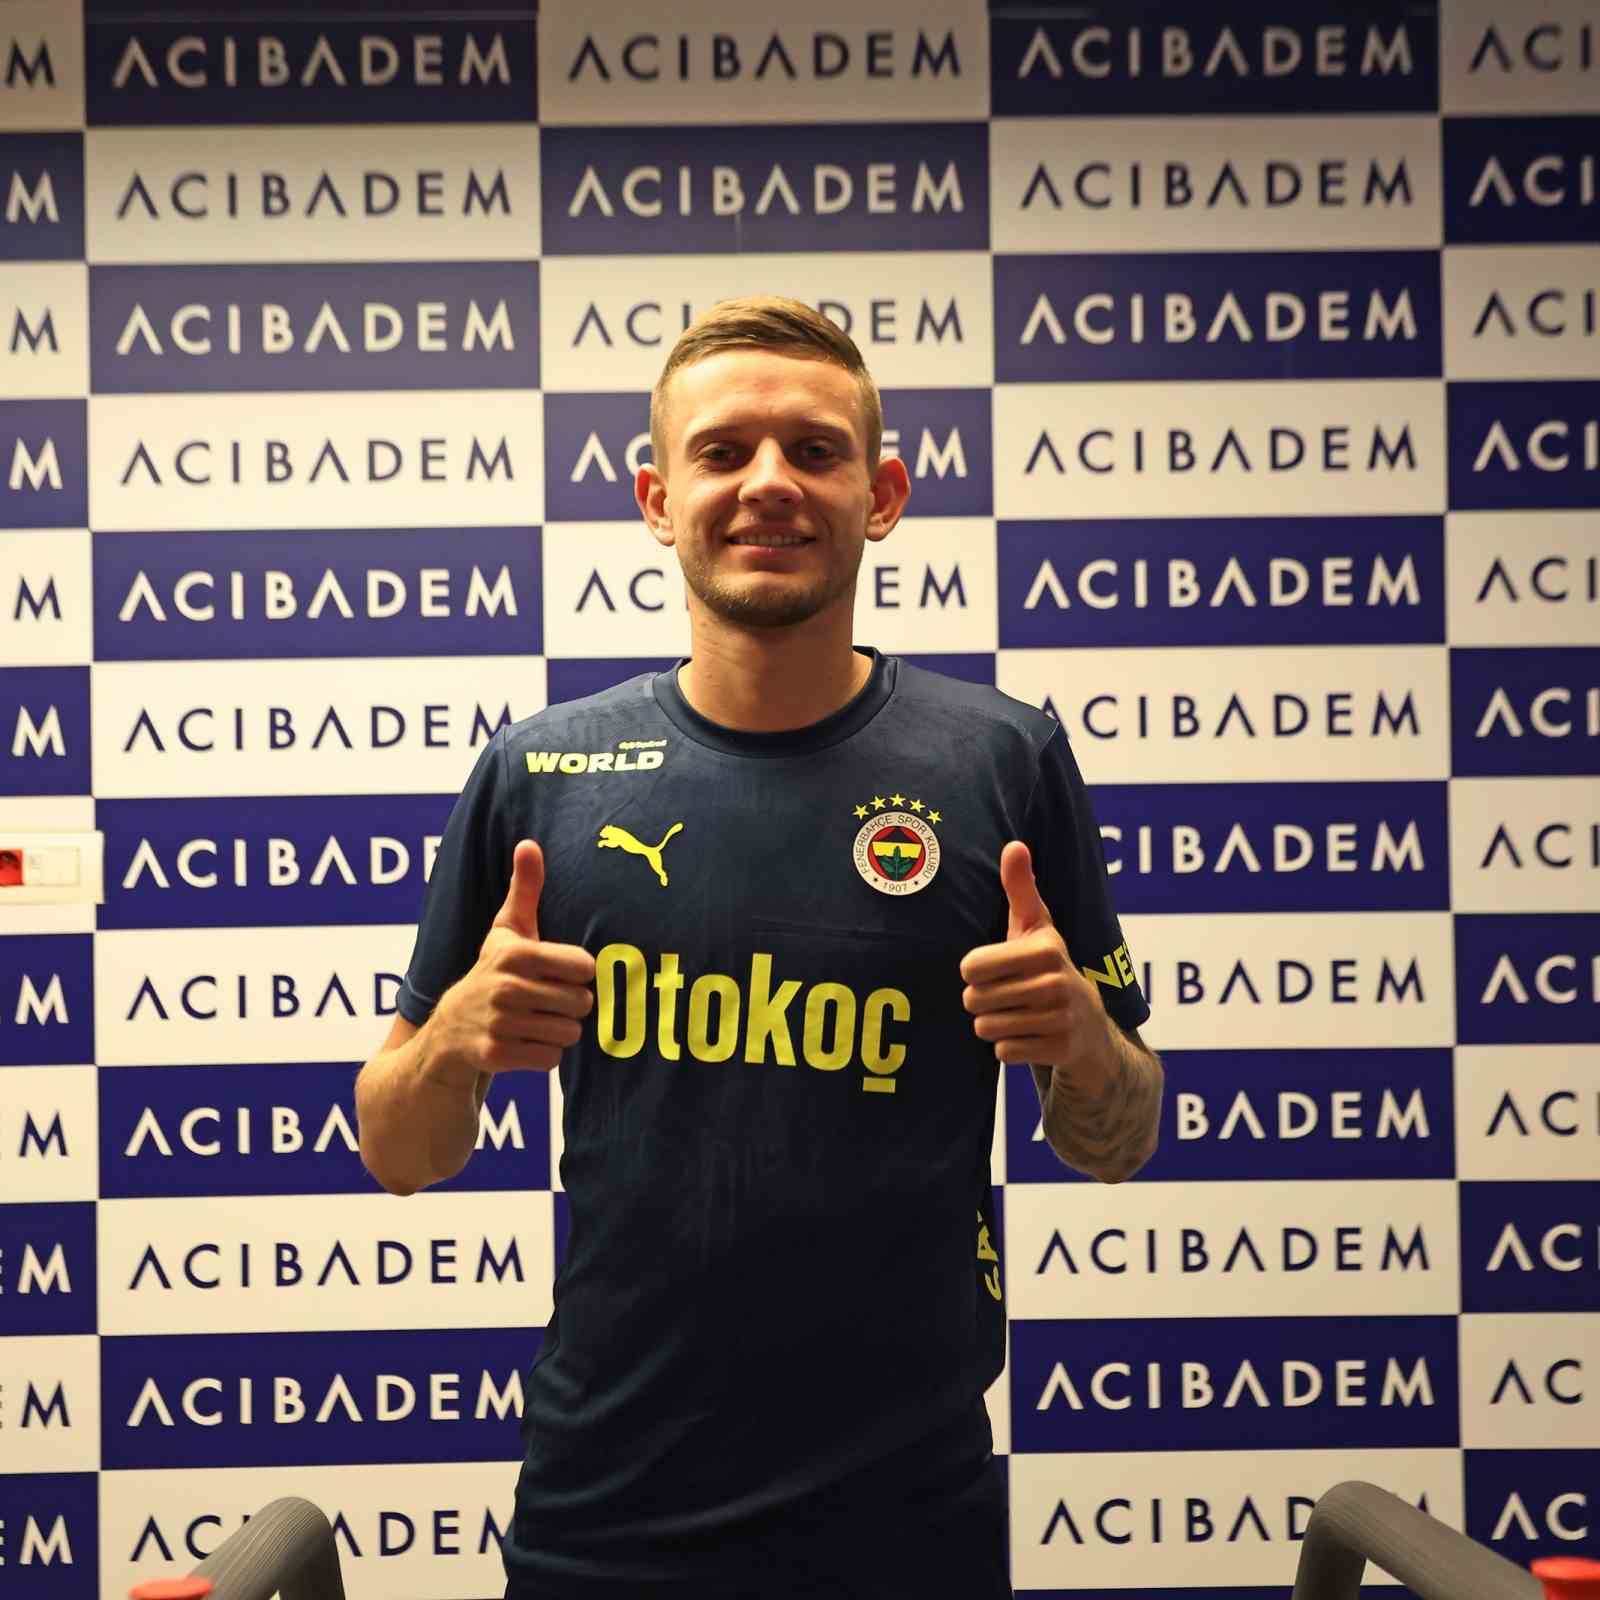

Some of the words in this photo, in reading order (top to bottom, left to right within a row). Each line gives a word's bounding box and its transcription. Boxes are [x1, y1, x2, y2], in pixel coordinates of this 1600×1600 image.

[114, 35, 510, 87] ACIBADEM
[568, 31, 961, 81] ACIBADEM
[1018, 27, 1412, 78] ACIBADEM
[117, 169, 511, 219] ACIBADEM
[568, 163, 963, 217] ACIBADEM
[1021, 156, 1414, 209] ACIBADEM
[116, 301, 515, 355] ACIBADEM
[1020, 292, 1416, 345] ACIBADEM
[121, 437, 514, 485] ACIBADEM
[1025, 424, 1417, 474] ACIBADEM
[119, 565, 518, 622] ACIBADEM
[1023, 556, 1420, 610] ACIBADEM
[124, 703, 512, 753] ACIBADEM
[525, 751, 664, 774] WORLD
[595, 943, 911, 1093] Otokoç
[0, 1244, 71, 1295] M
[128, 1237, 525, 1290] ACIBADEM
[1036, 1226, 1430, 1275] ACIBADEM
[0, 1383, 71, 1428] M
[126, 1368, 525, 1428] ACIBADEM
[1036, 1358, 1434, 1411] ACIBADEM
[0, 1515, 73, 1566] M
